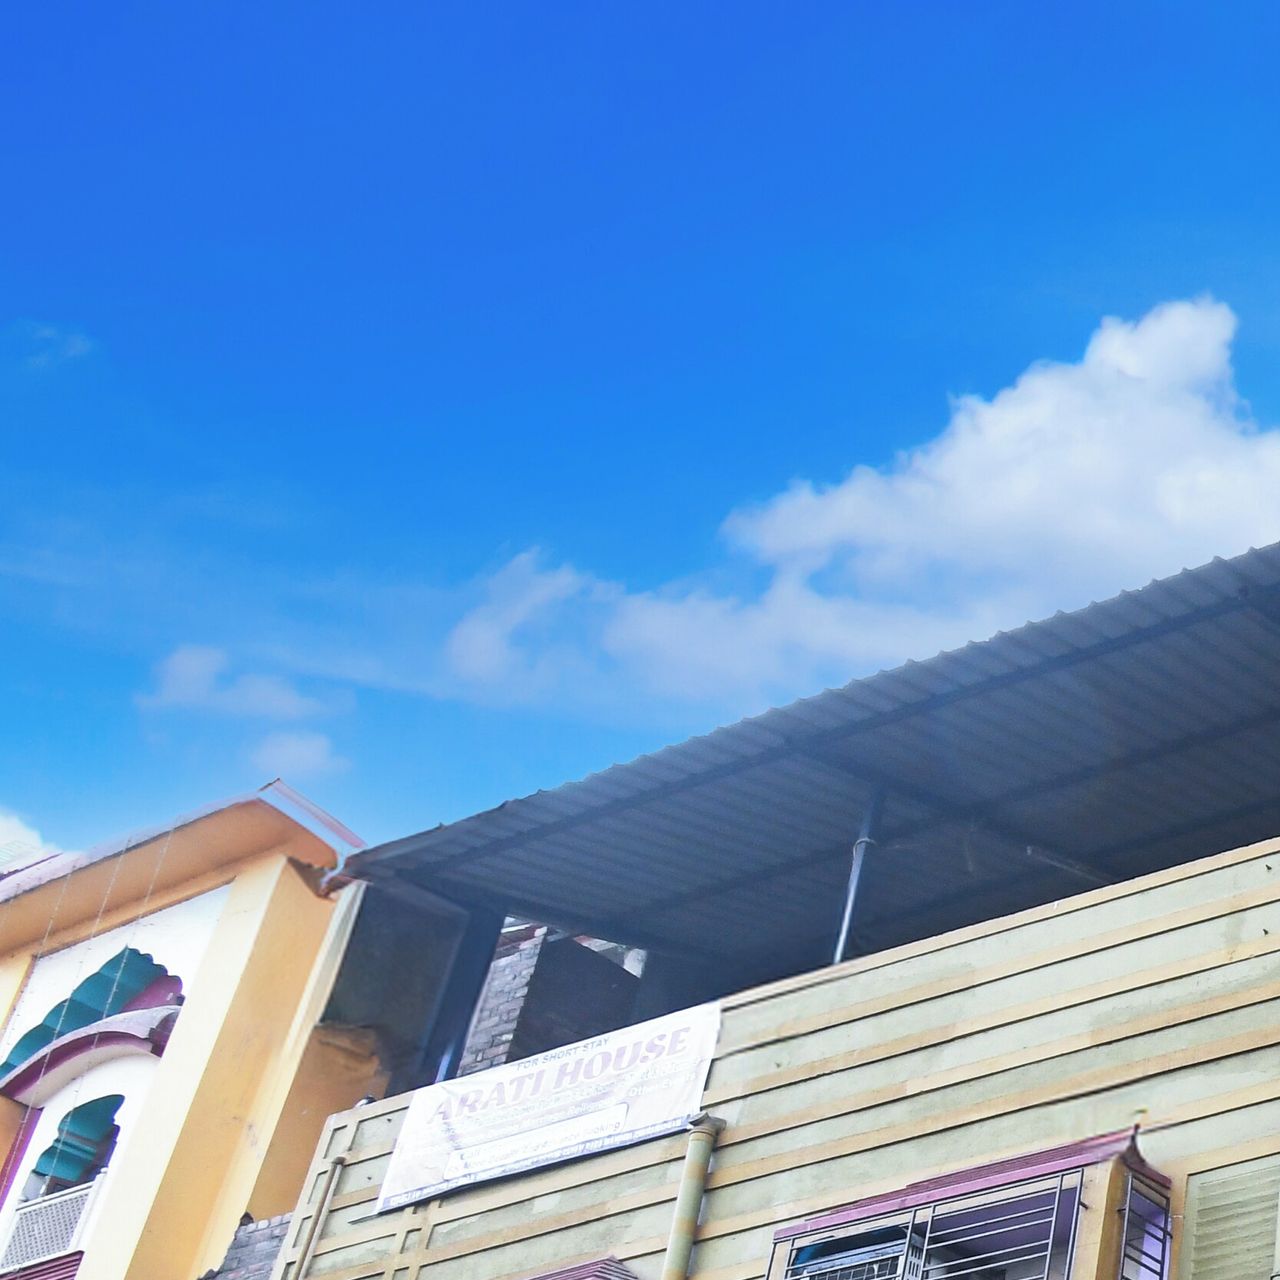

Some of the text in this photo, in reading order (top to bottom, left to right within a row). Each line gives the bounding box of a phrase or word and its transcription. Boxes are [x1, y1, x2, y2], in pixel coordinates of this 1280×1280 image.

[583, 1037, 610, 1053] STAY
[430, 1072, 544, 1123] ARATI
[553, 1026, 691, 1090] HOUSE
